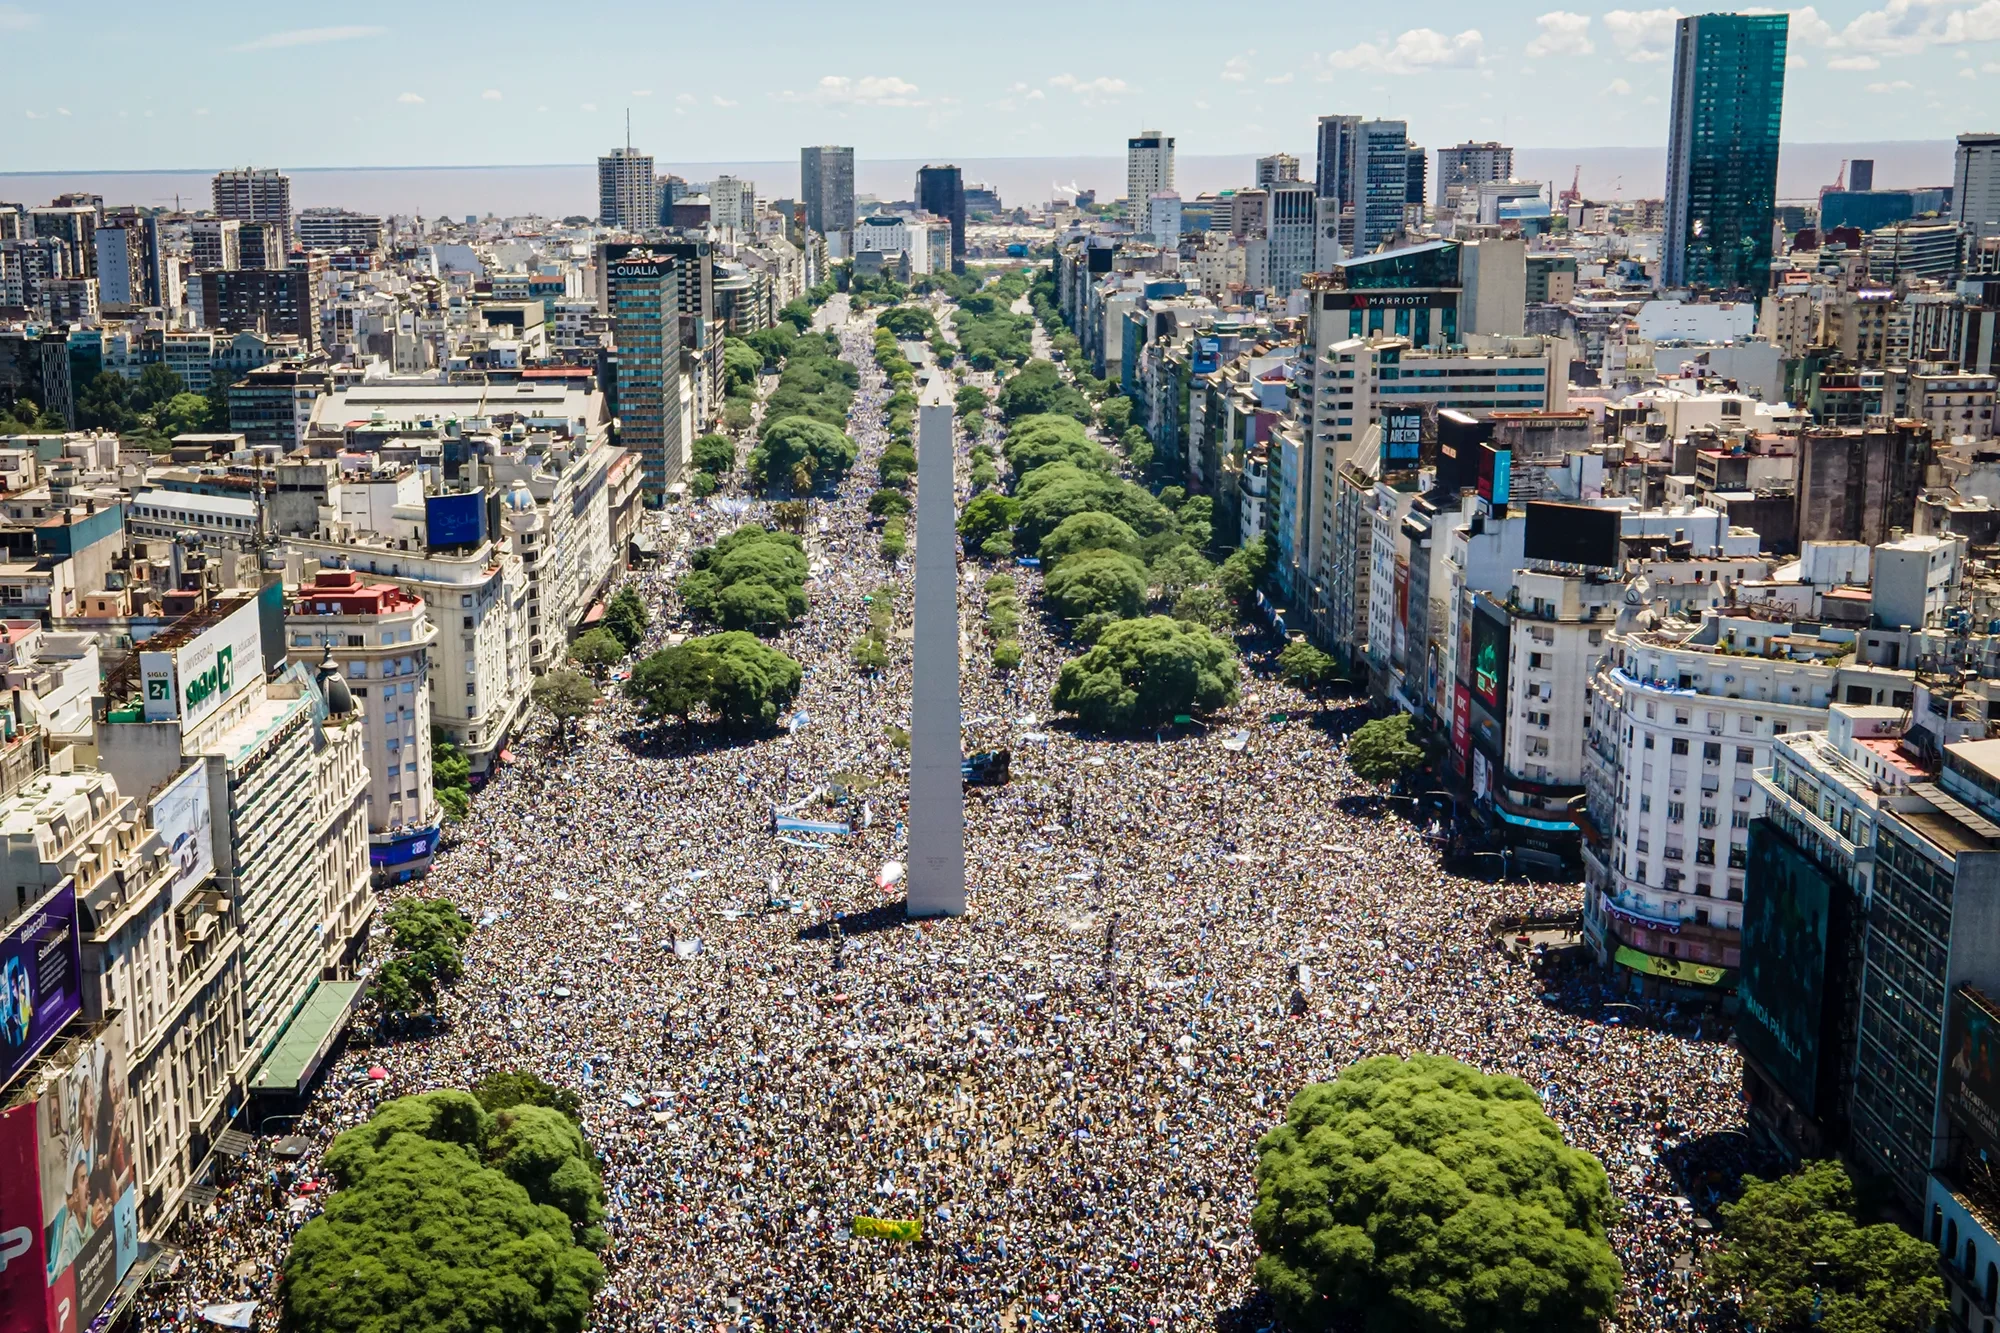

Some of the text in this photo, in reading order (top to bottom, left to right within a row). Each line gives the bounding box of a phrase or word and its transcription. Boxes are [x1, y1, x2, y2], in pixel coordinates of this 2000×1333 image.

[617, 266, 659, 276] QUALIA
[1369, 296, 1429, 305] MARRIOTT
[1390, 429, 1404, 442] ARE
[1391, 415, 1420, 428] WE
[183, 643, 214, 673] UNIVERSIDAD
[151, 683, 167, 700] 21
[185, 664, 218, 711] SIGLO
[21, 912, 48, 944] telecom
[38, 932, 62, 961] Soluciones
[1960, 1094, 1998, 1137] PATAGONIA
[79, 1250, 99, 1281] Delivery
